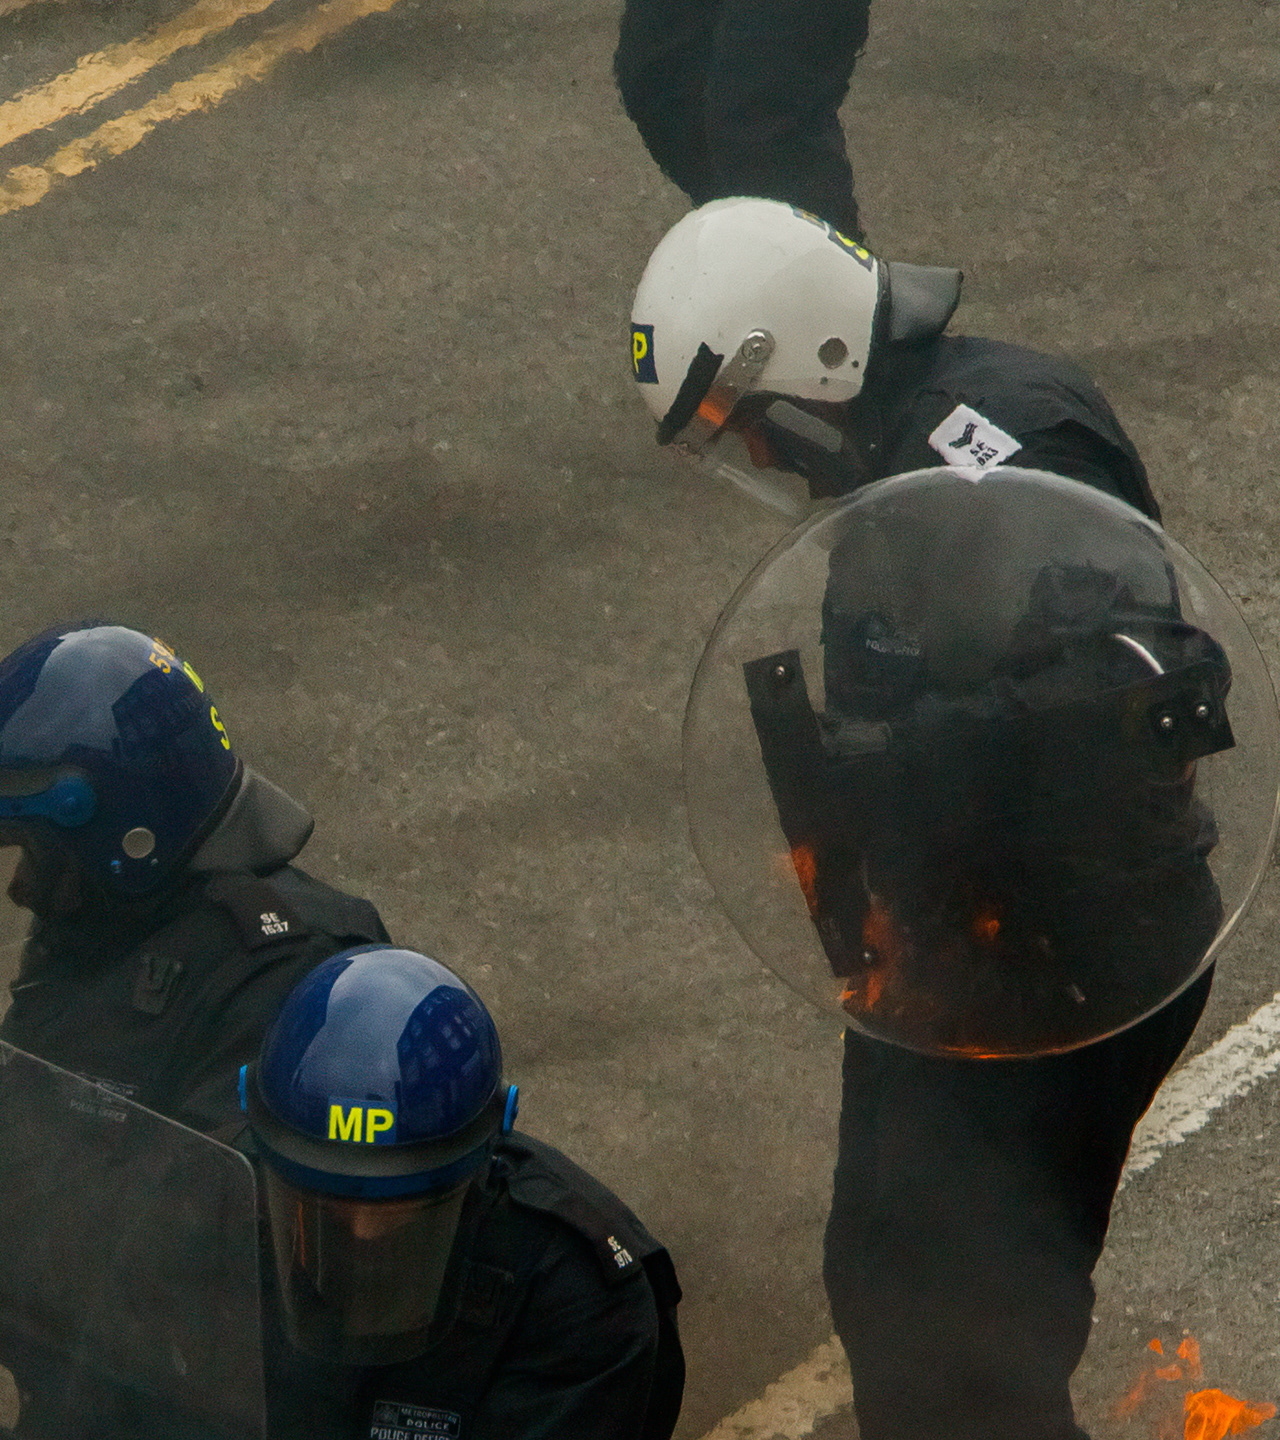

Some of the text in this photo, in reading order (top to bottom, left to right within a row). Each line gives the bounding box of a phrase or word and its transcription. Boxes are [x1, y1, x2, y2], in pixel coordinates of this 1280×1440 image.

[149, 637, 176, 674] 59
[260, 912, 281, 924] SE
[328, 1104, 395, 1143] MP
[406, 1418, 449, 1431] POLICE
